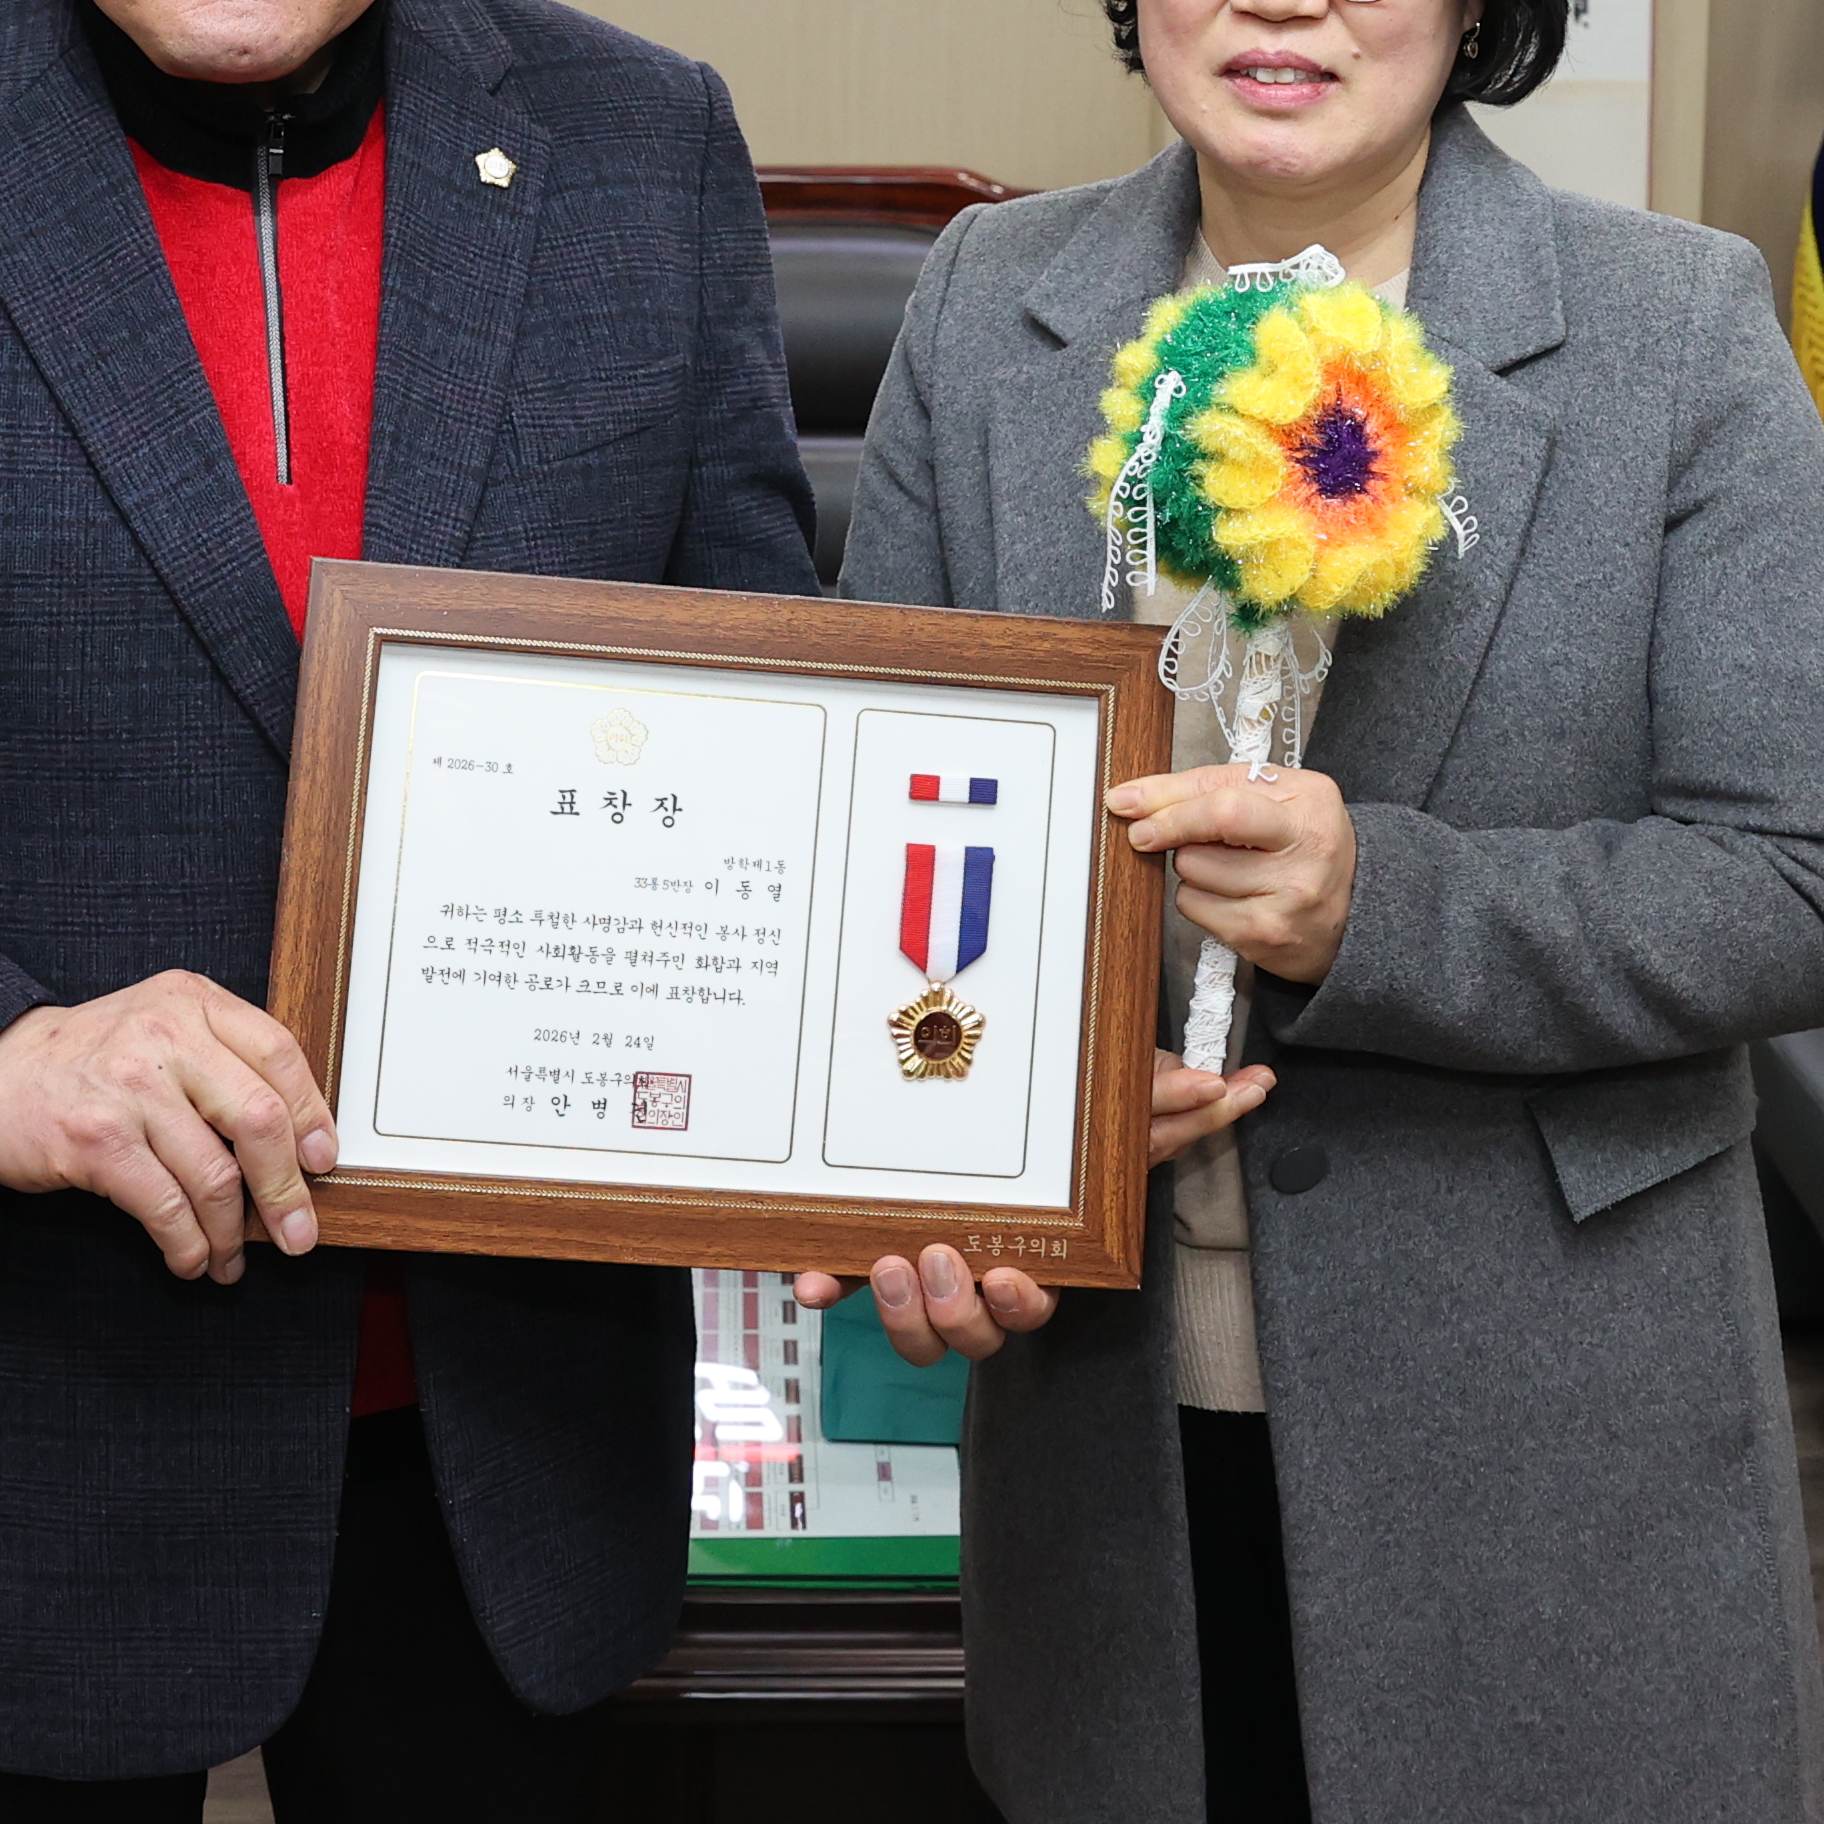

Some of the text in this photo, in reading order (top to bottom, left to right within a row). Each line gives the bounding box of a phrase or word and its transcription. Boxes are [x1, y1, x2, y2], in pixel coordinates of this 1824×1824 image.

[447, 758, 499, 773] 2026-30
[502, 762, 514, 774] 호
[724, 856, 786, 875] 방학제1동
[440, 902, 781, 946] 귀하는 평소 투철한 사명감과 헌신적인 봉사 정신
[423, 935, 455, 951] 으로
[465, 937, 526, 959] 적극적인
[537, 942, 616, 966] 사회활동을
[695, 954, 742, 974] 화합과
[751, 959, 779, 978] 지역
[421, 965, 746, 1007] 발전에 기여한 공로가 크므로 이에 표창합니다.
[533, 1028, 655, 1051] 2026년 2월 24일
[917, 1023, 957, 1046] 의회
[505, 1064, 649, 1090] 서울특별시 도봉구의회
[962, 1234, 1069, 1260] 도봉구의회
